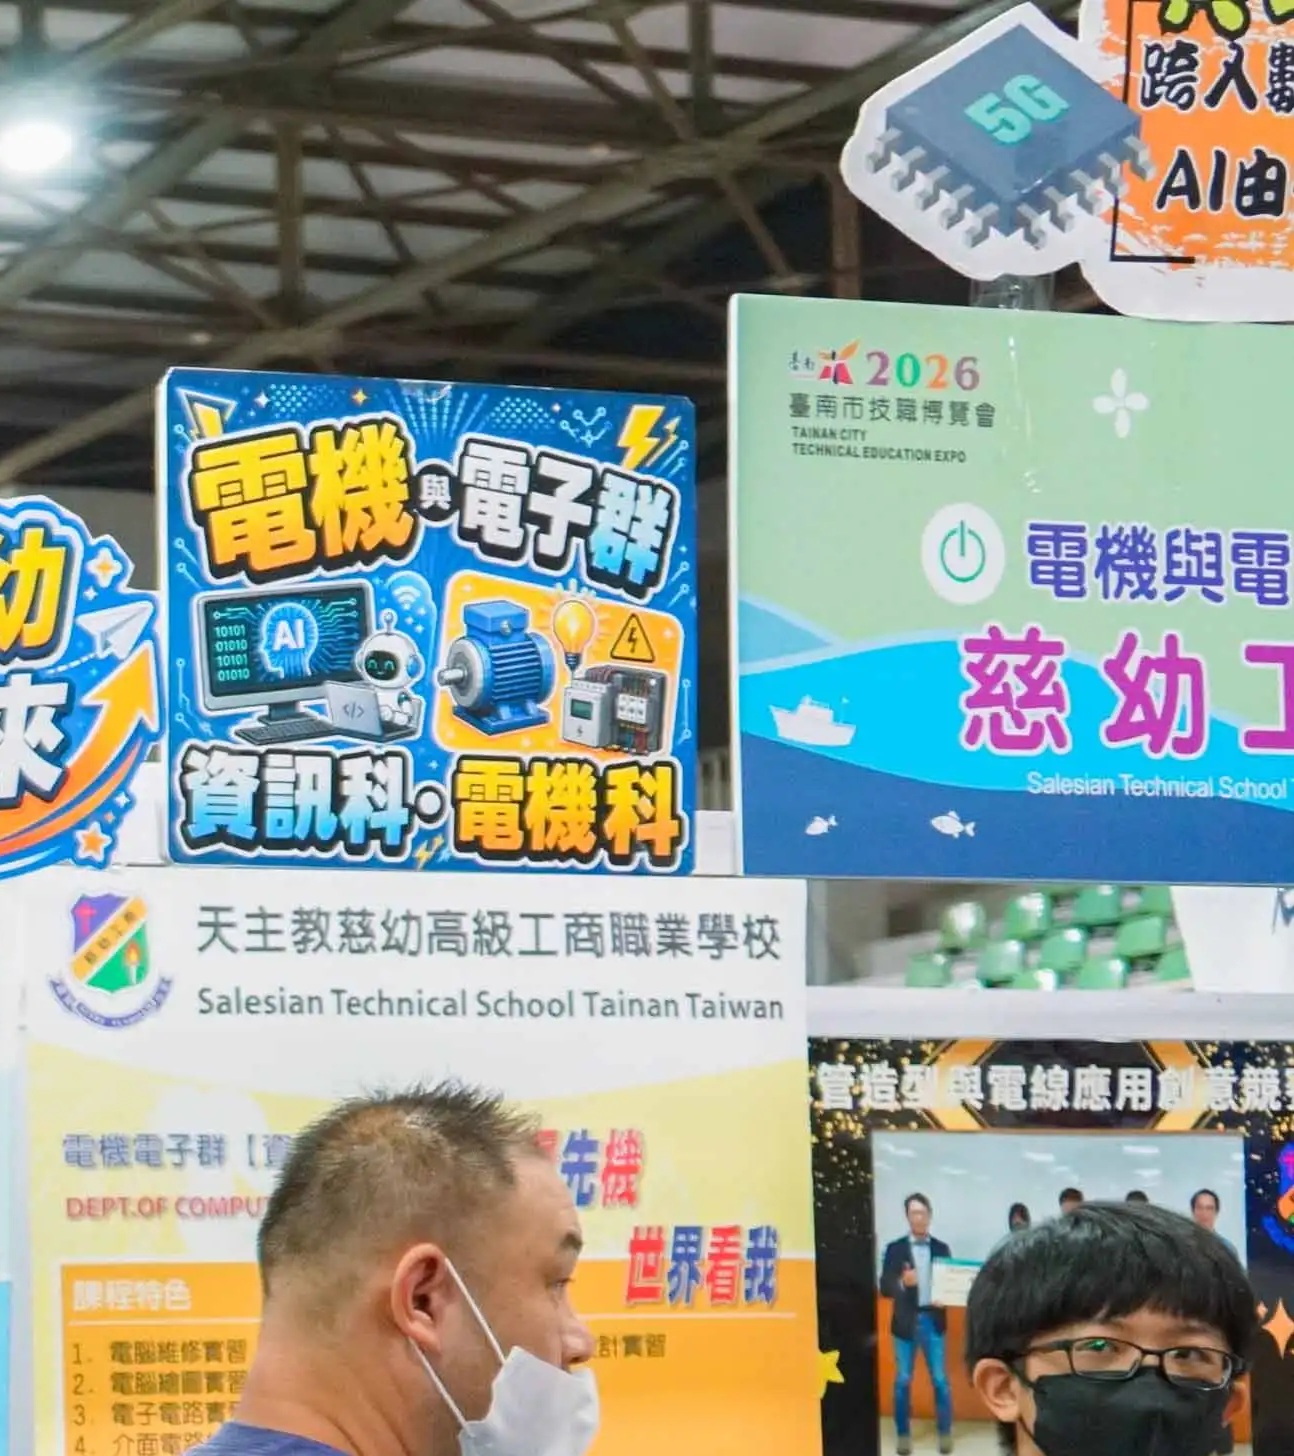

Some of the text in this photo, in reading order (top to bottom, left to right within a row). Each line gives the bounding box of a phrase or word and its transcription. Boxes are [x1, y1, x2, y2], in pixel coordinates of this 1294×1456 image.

[964, 74, 1072, 146] 5G
[865, 350, 980, 391] 2026
[788, 392, 996, 429] 臺南市技職博覽會
[791, 425, 867, 442] TAINAN CITY
[791, 442, 967, 464] TECHNICAL EDUCATION EXPO
[192, 416, 676, 588] 電機與電子群
[1027, 522, 1290, 606] 電機與電
[214, 624, 246, 638] 10101
[272, 618, 306, 651] AI
[1027, 771, 1288, 801] Salesian Technical School
[196, 903, 781, 962] 天主教慈幼高級工商職業學校
[197, 987, 324, 1018] Salesian
[331, 988, 468, 1019] Technical
[475, 989, 575, 1020] School
[582, 990, 679, 1021] Tainan
[684, 992, 784, 1022] Taiwan
[817, 1060, 1294, 1113] 管造型與電線應用創意競
[625, 1224, 779, 1305] 世界看我
[111, 1400, 242, 1427] 電子電路實
